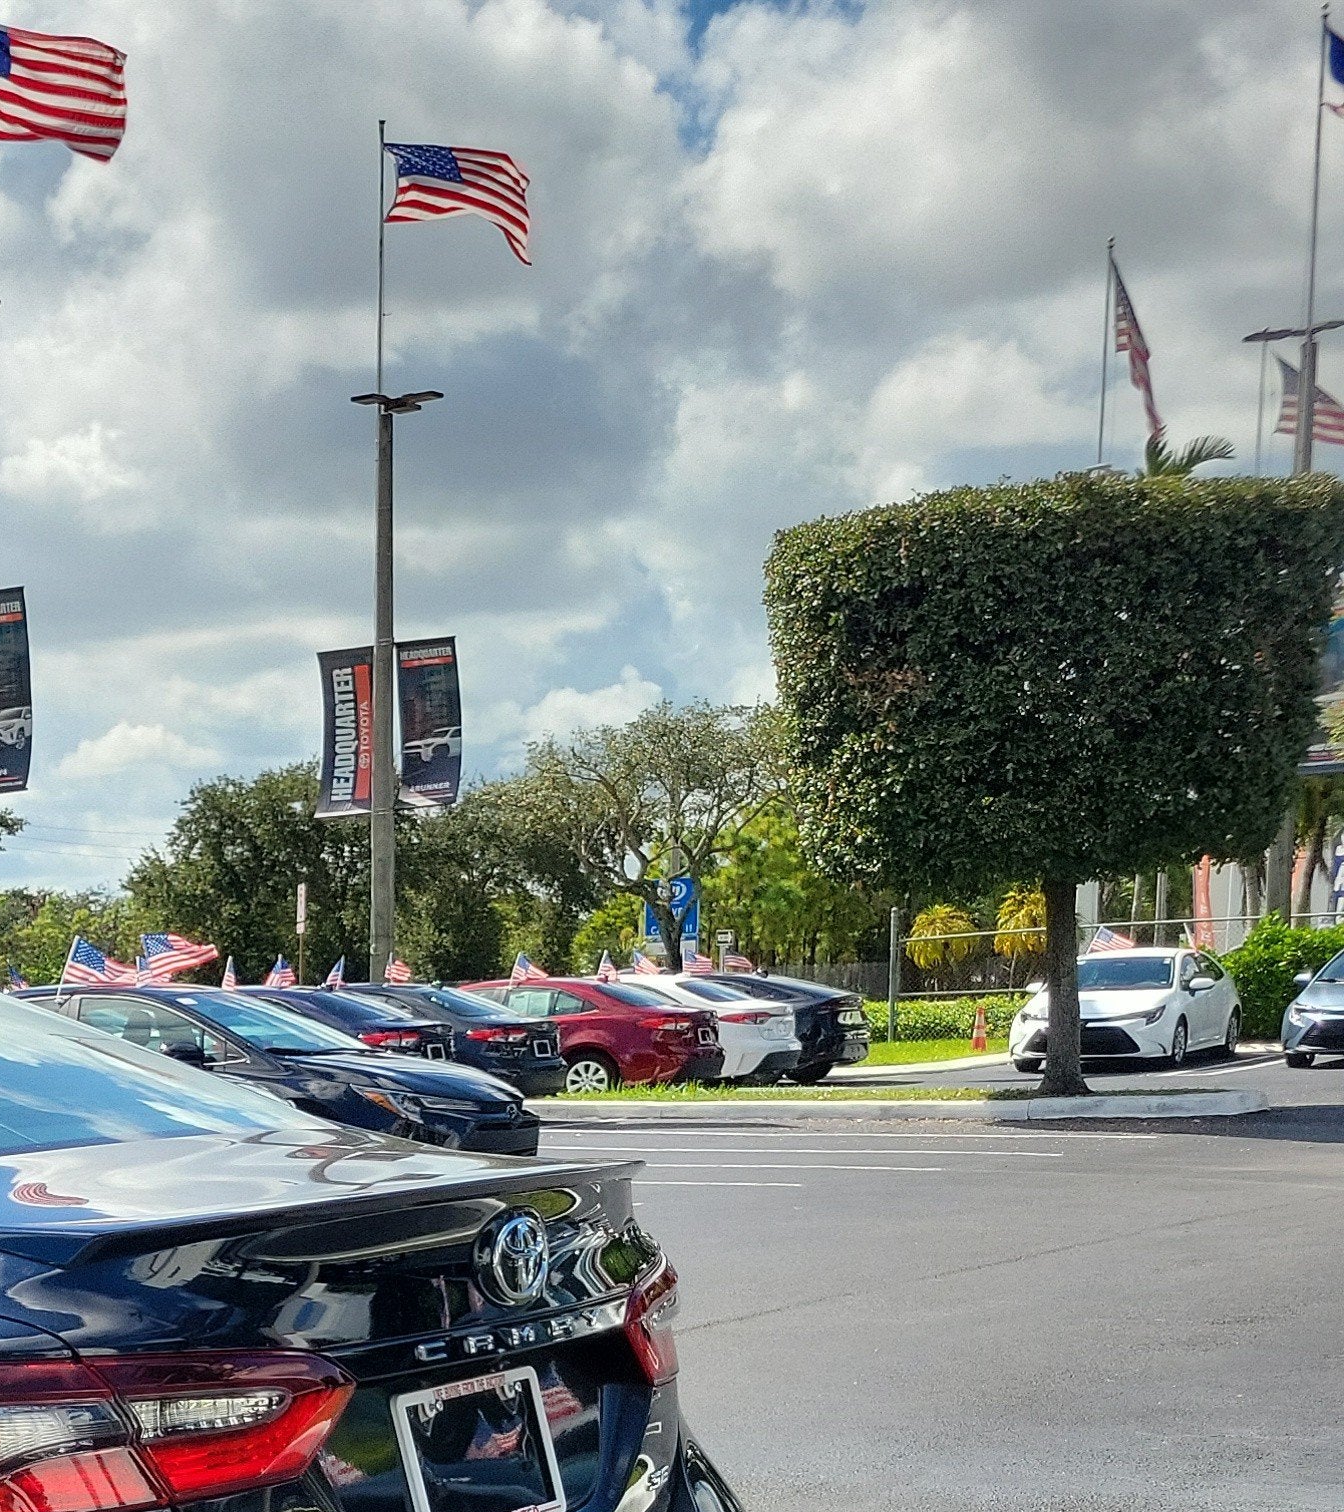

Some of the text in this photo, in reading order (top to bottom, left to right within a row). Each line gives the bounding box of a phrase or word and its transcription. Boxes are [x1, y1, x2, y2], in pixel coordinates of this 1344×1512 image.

[330, 667, 358, 802] HEADQUARTER
[359, 701, 371, 747] TOYOTA
[414, 1308, 603, 1362] CAMRY
[647, 1465, 670, 1491] SE
